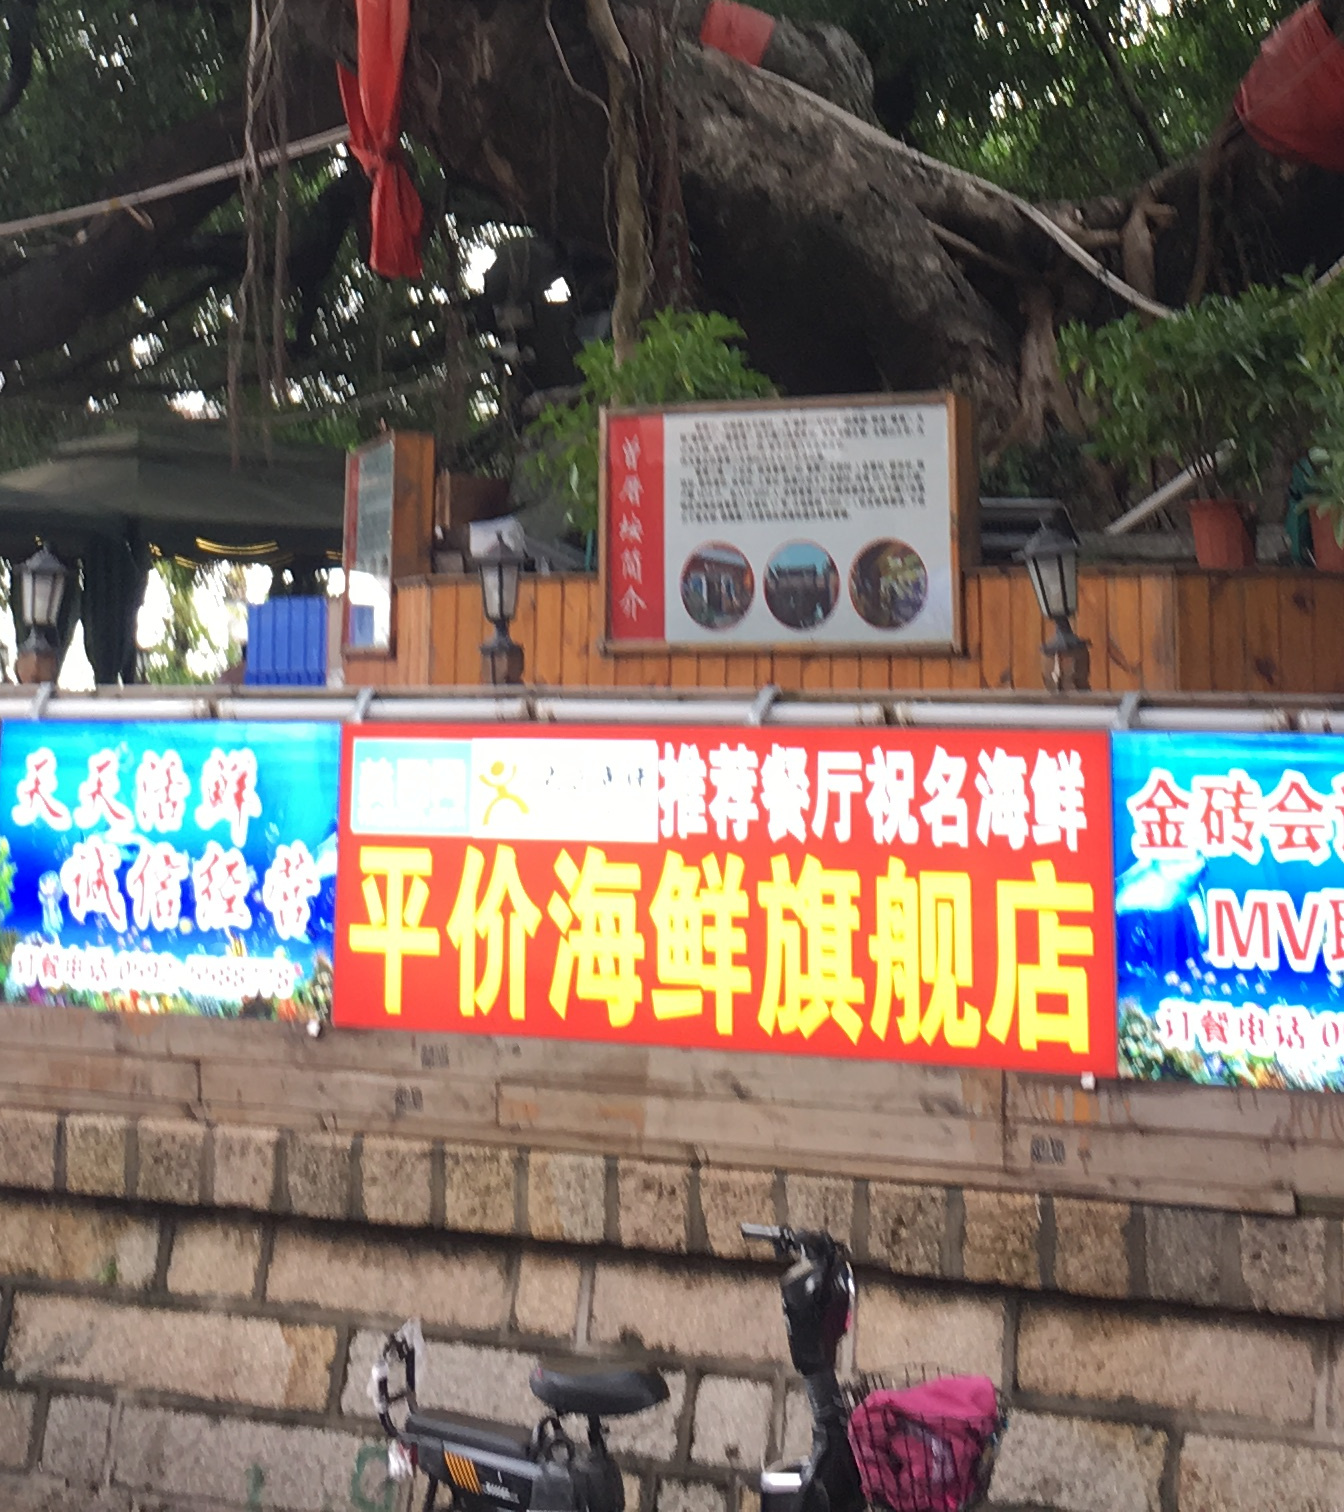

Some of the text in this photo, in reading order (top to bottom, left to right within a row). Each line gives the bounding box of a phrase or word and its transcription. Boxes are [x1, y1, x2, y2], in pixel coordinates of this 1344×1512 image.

[13, 748, 262, 846] 天天活鲜
[658, 742, 1087, 851] 推荐餐厅祝名海鲜
[61, 835, 320, 940] 诚信经营
[349, 843, 1094, 1052] 平价海鲜旗舰店
[1159, 1000, 1313, 1059] 订餐电话
